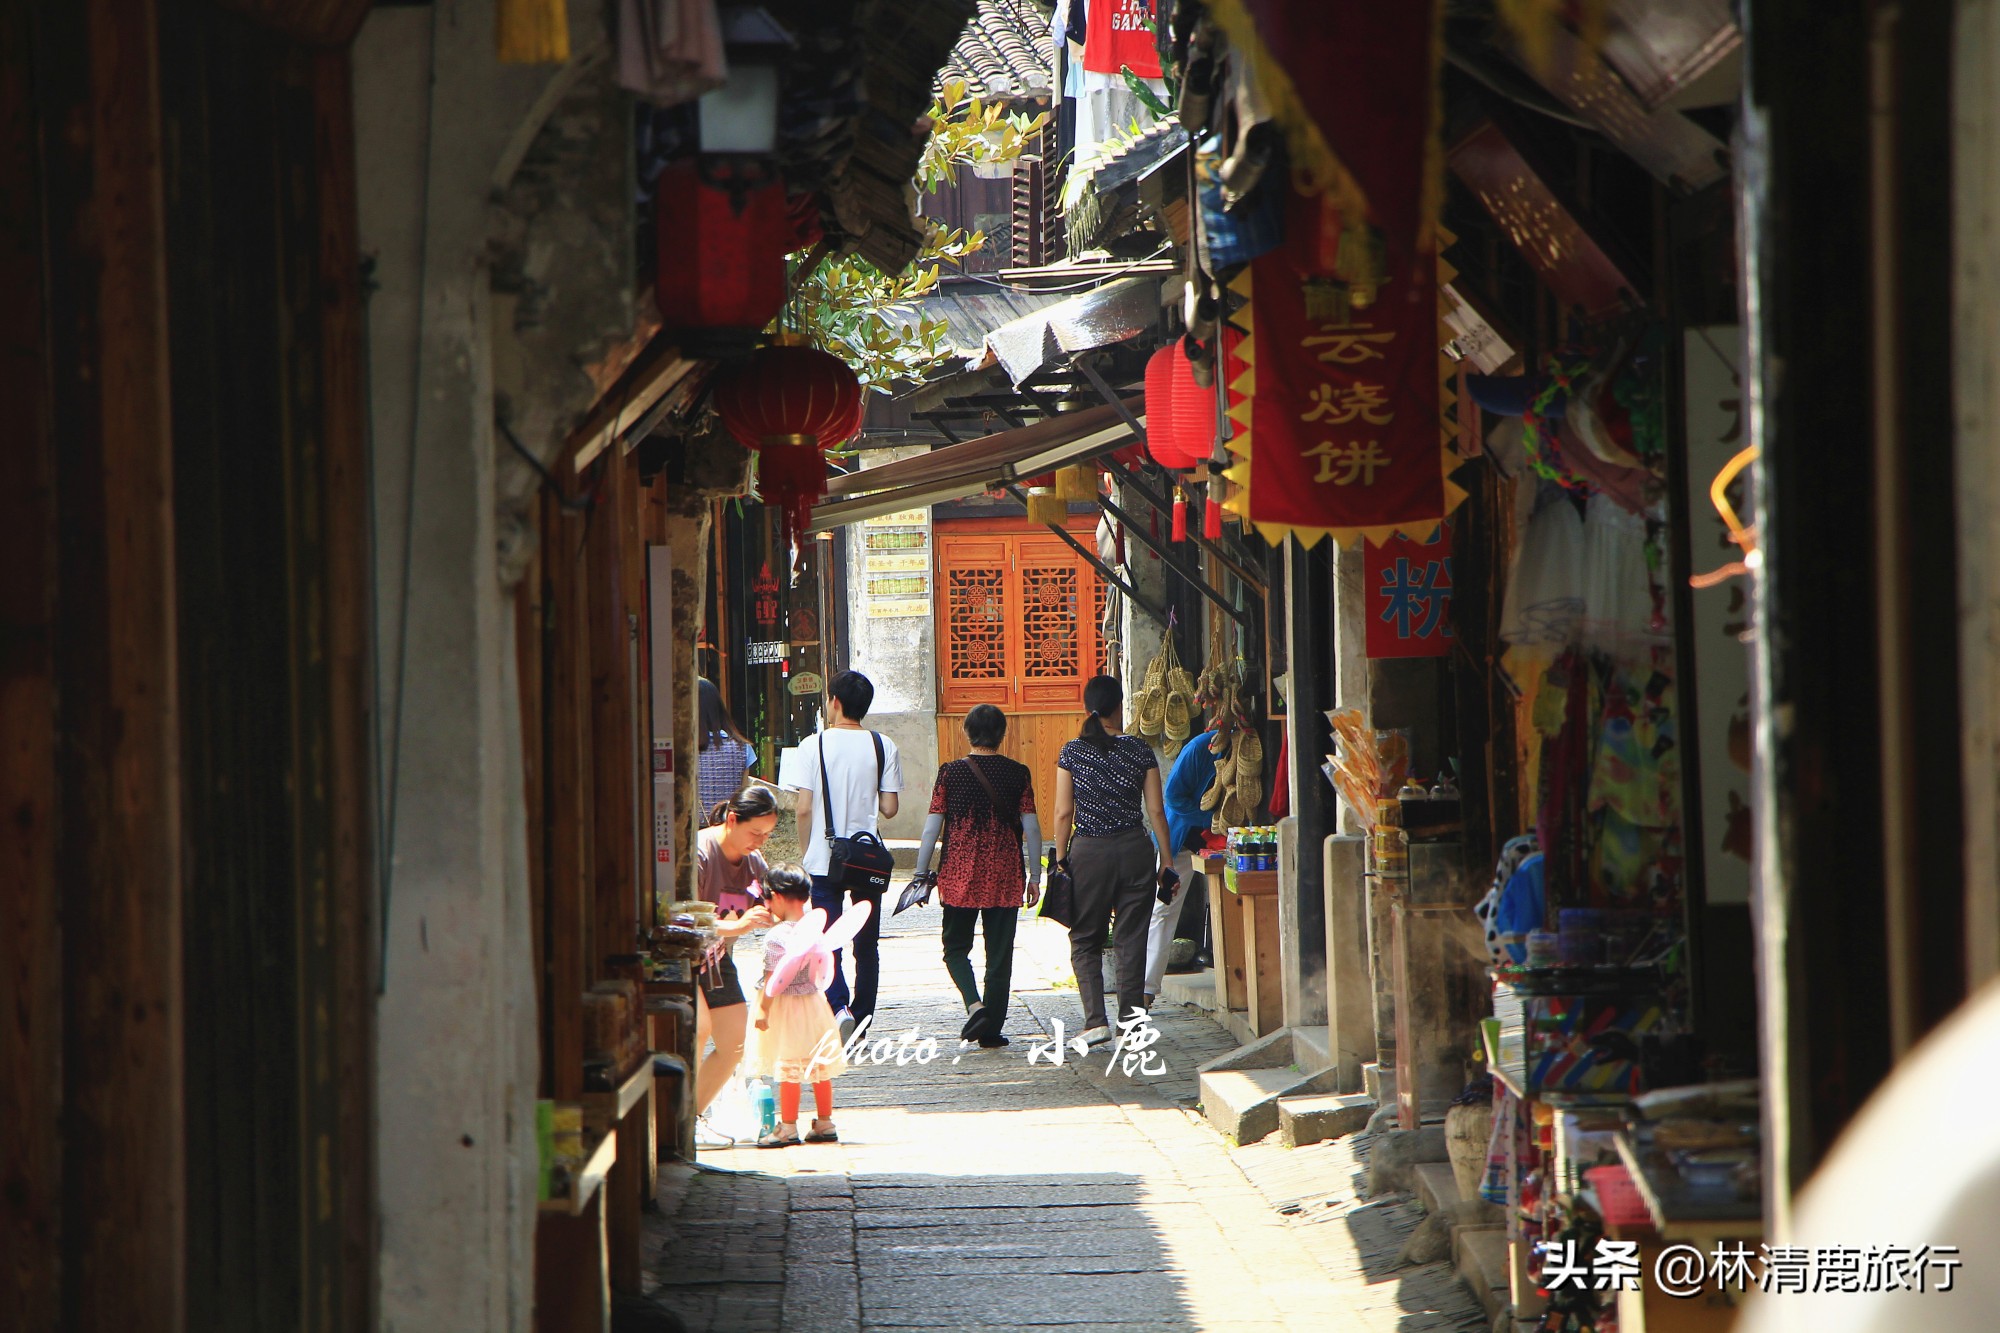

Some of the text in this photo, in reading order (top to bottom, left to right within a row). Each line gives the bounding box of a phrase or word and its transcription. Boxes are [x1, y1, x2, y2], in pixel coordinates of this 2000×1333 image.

[1300, 278, 1396, 487] 云烧饼
[1380, 524, 1454, 639] 粉
[869, 876, 885, 885] EOS
